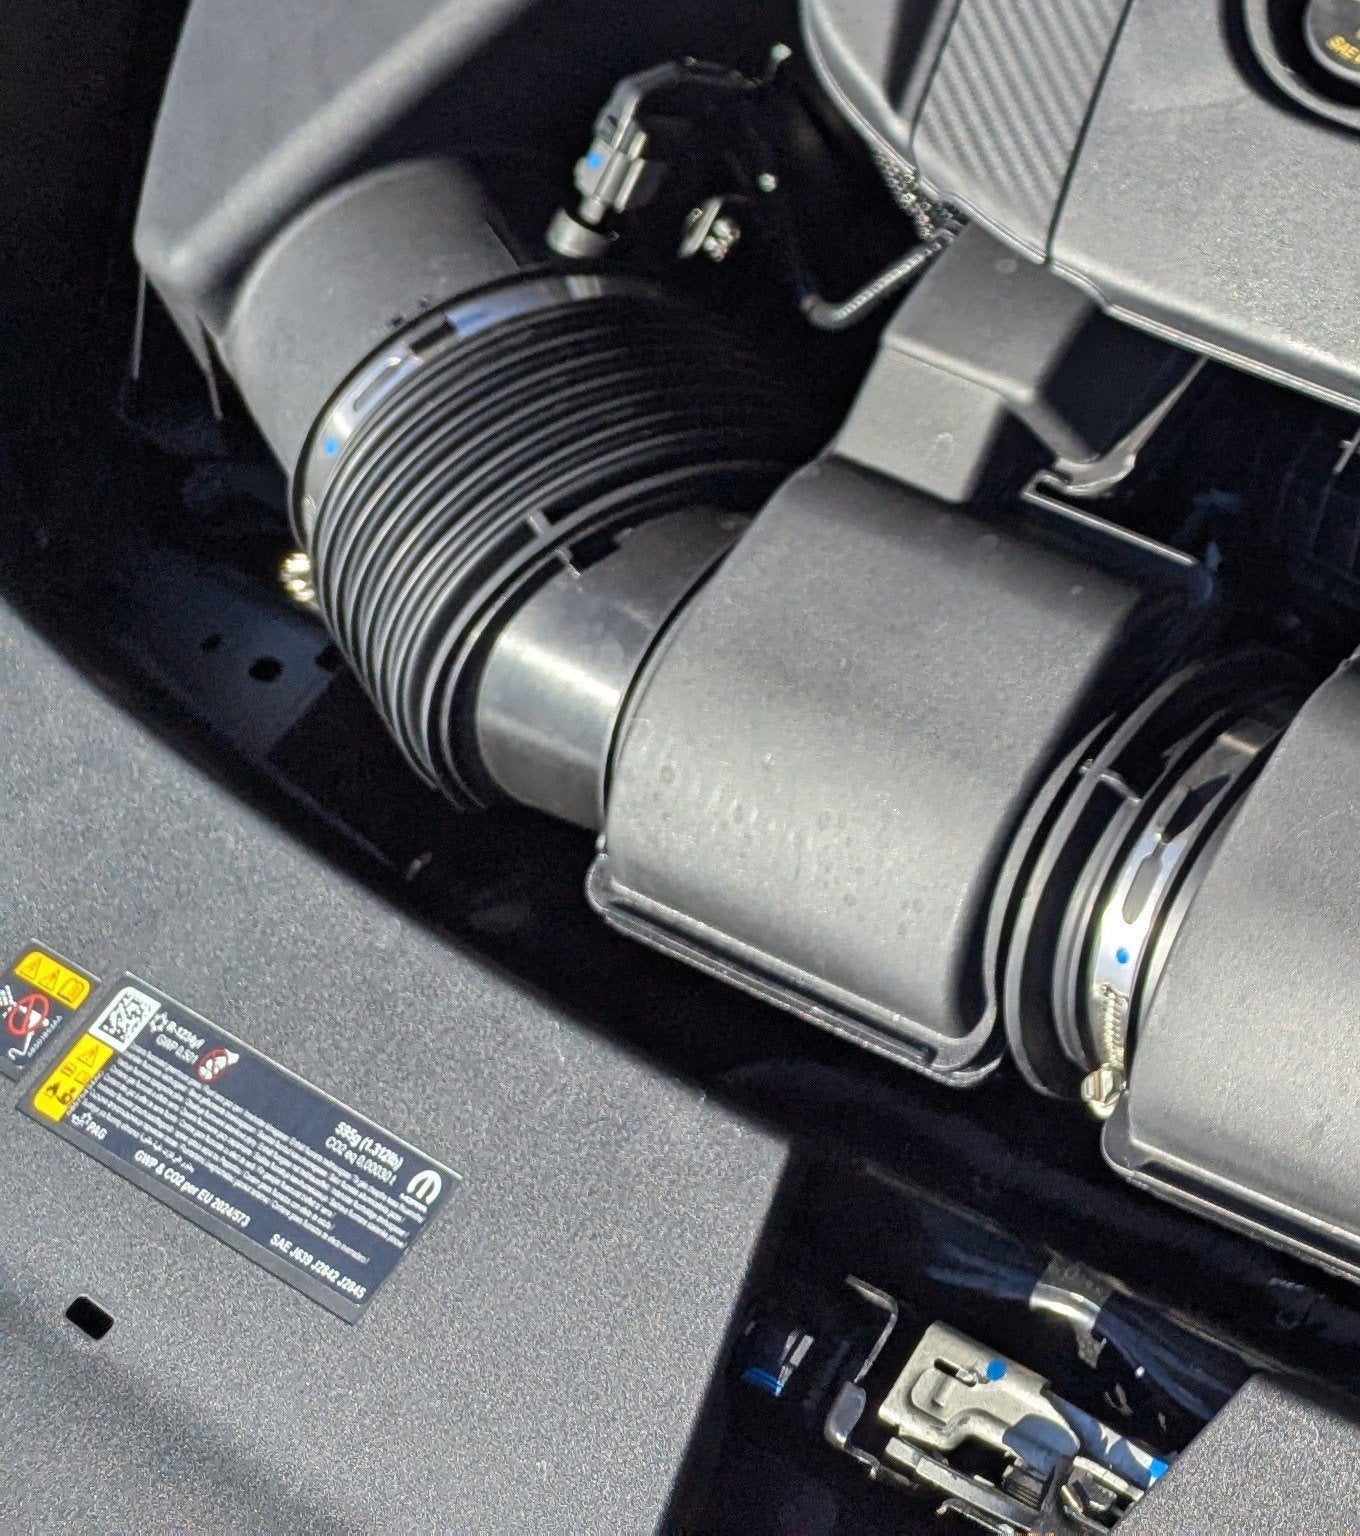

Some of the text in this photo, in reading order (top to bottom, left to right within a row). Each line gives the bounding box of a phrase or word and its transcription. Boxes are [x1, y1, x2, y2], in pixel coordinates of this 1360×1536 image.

[1325, 35, 1358, 62] SAE
[86, 1121, 107, 1139] PAG
[325, 1135, 347, 1154] CO2
[134, 1150, 157, 1169] GWP
[163, 1168, 184, 1186] CO2
[180, 1181, 198, 1197] per
[196, 1188, 213, 1203] EU
[270, 1233, 291, 1252] SAE
